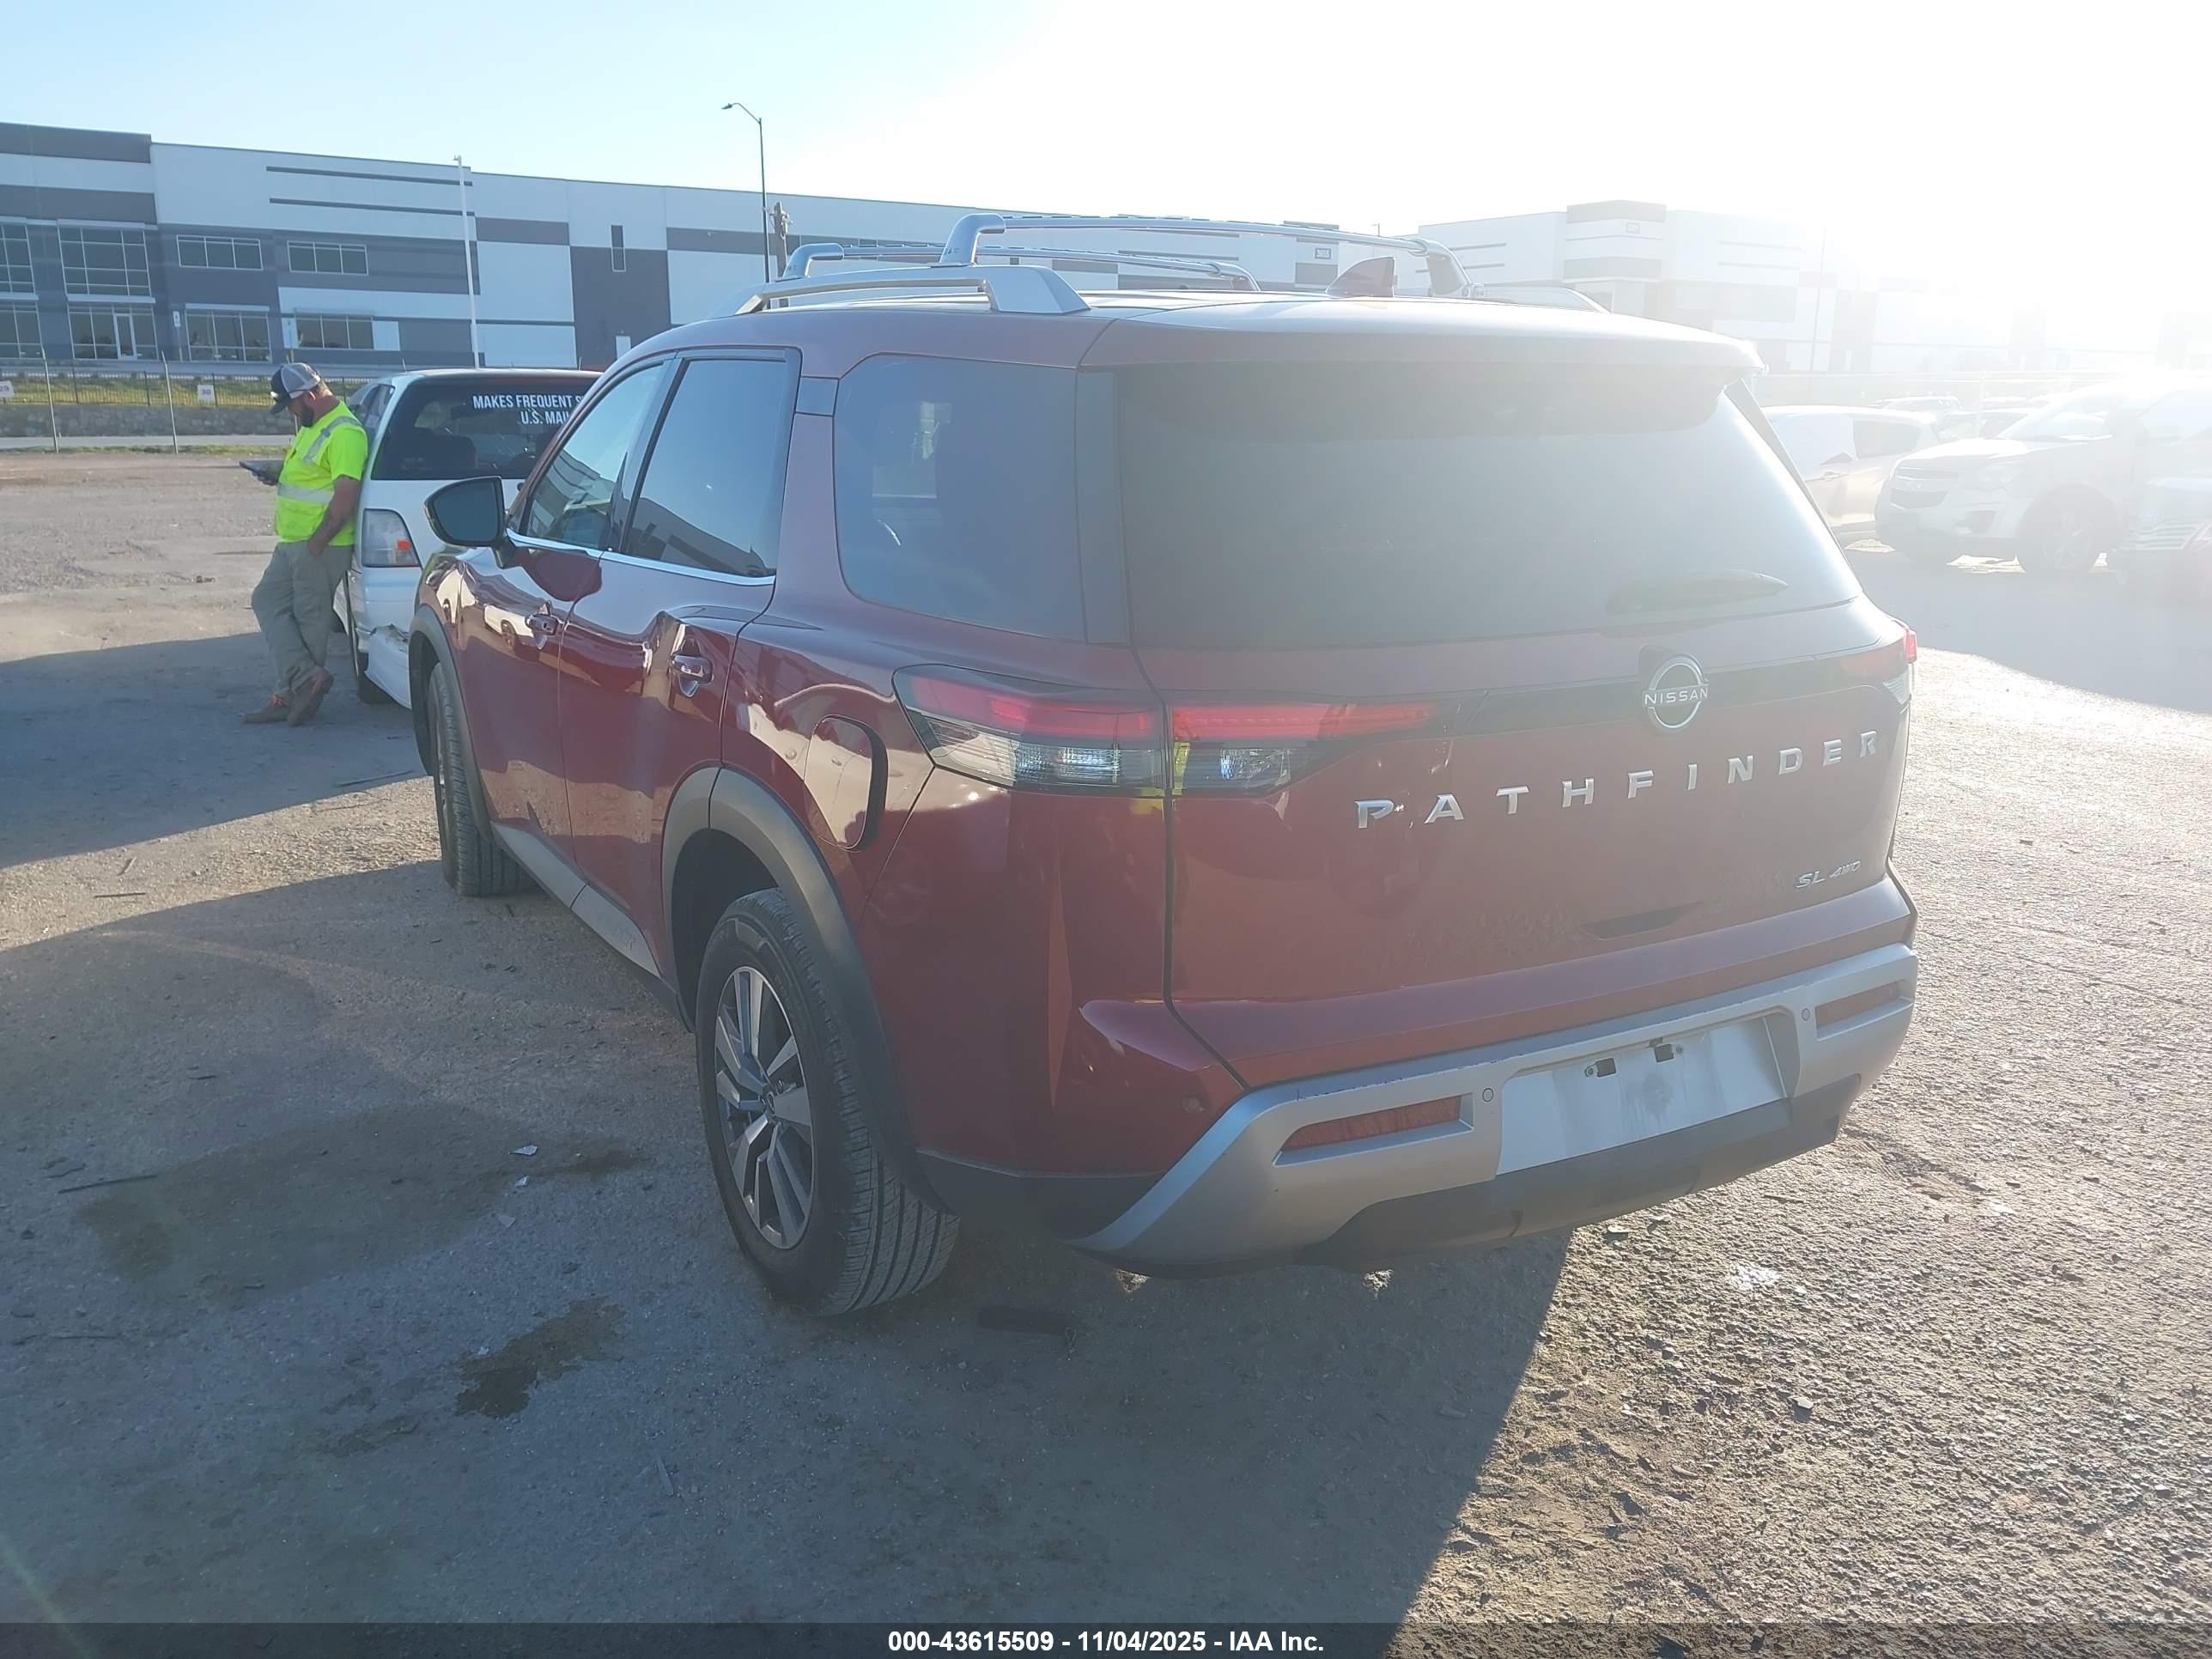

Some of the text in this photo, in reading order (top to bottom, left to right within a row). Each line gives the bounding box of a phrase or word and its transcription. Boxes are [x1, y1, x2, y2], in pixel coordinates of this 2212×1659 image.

[472, 394, 514, 410] MAKES
[516, 394, 573, 409] FREQUENT
[520, 410, 543, 425] U.S.
[1644, 686, 1708, 705] NISSAN
[1355, 730, 1881, 830] PATHFINDER
[1796, 860, 1861, 888] SL 4WD
